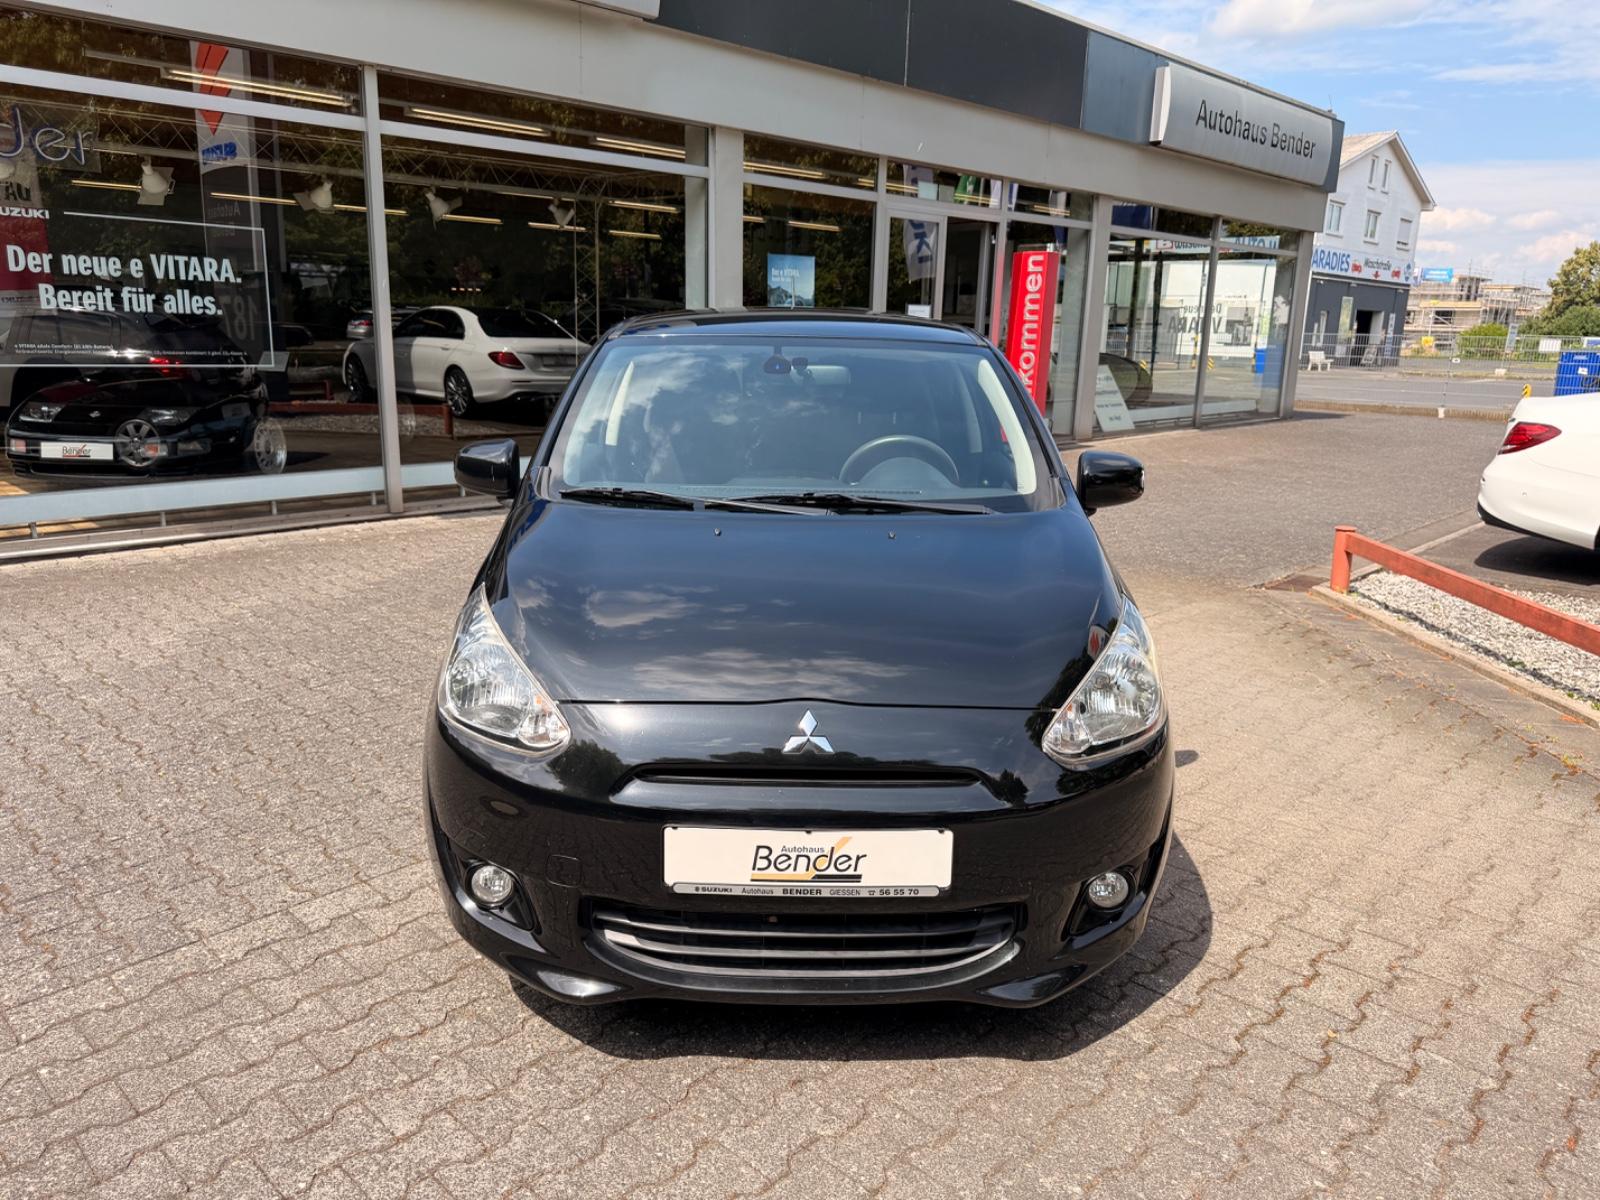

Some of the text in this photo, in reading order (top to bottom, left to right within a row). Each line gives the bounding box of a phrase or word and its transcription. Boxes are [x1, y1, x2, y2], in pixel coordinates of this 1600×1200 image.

[1195, 99, 1317, 160] Autohaus Bender
[6, 244, 242, 284] Der neue e VITARA.
[38, 282, 223, 315] Bereit für alles.
[752, 845, 867, 873] Bender
[781, 845, 825, 854] Autohaus
[741, 887, 774, 895] Autohaus
[782, 888, 822, 896] BENDER
[880, 888, 891, 896] 56
[908, 888, 920, 896] 70
